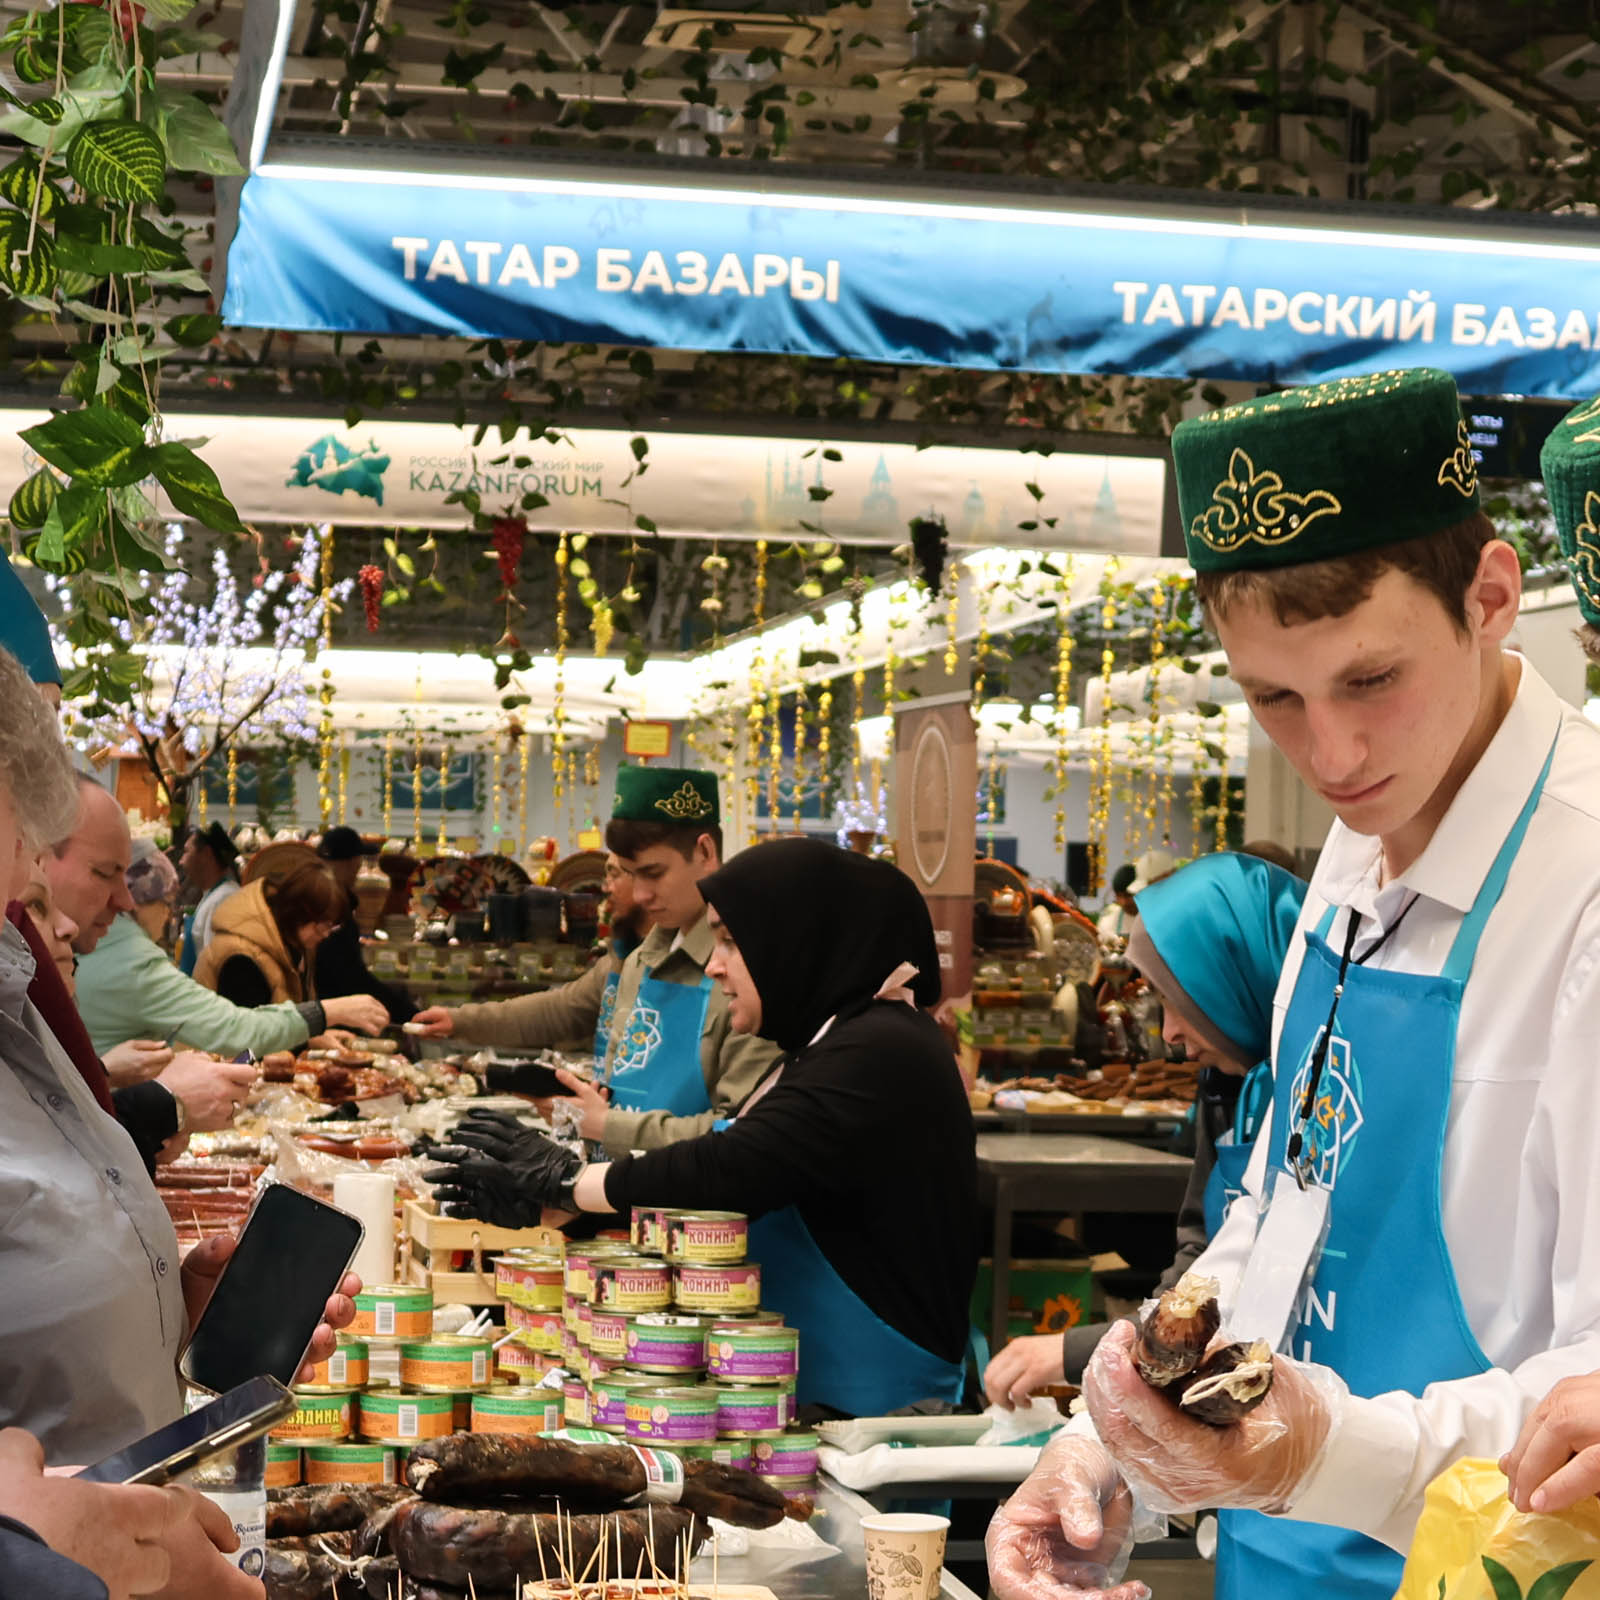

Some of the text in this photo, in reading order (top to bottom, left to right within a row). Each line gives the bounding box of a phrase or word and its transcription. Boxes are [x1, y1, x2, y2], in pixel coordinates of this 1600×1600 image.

[392, 236, 841, 302] ТАТАР БАЗАРЫ
[1113, 280, 1436, 343] ТАТАРСКИЙ
[409, 456, 467, 469] РОССИЯ
[409, 470, 603, 497] KAZANFORUM
[688, 1230, 736, 1245] КОНИНА
[619, 1277, 666, 1293] КОНИНА
[683, 1279, 730, 1293] КОНИНА
